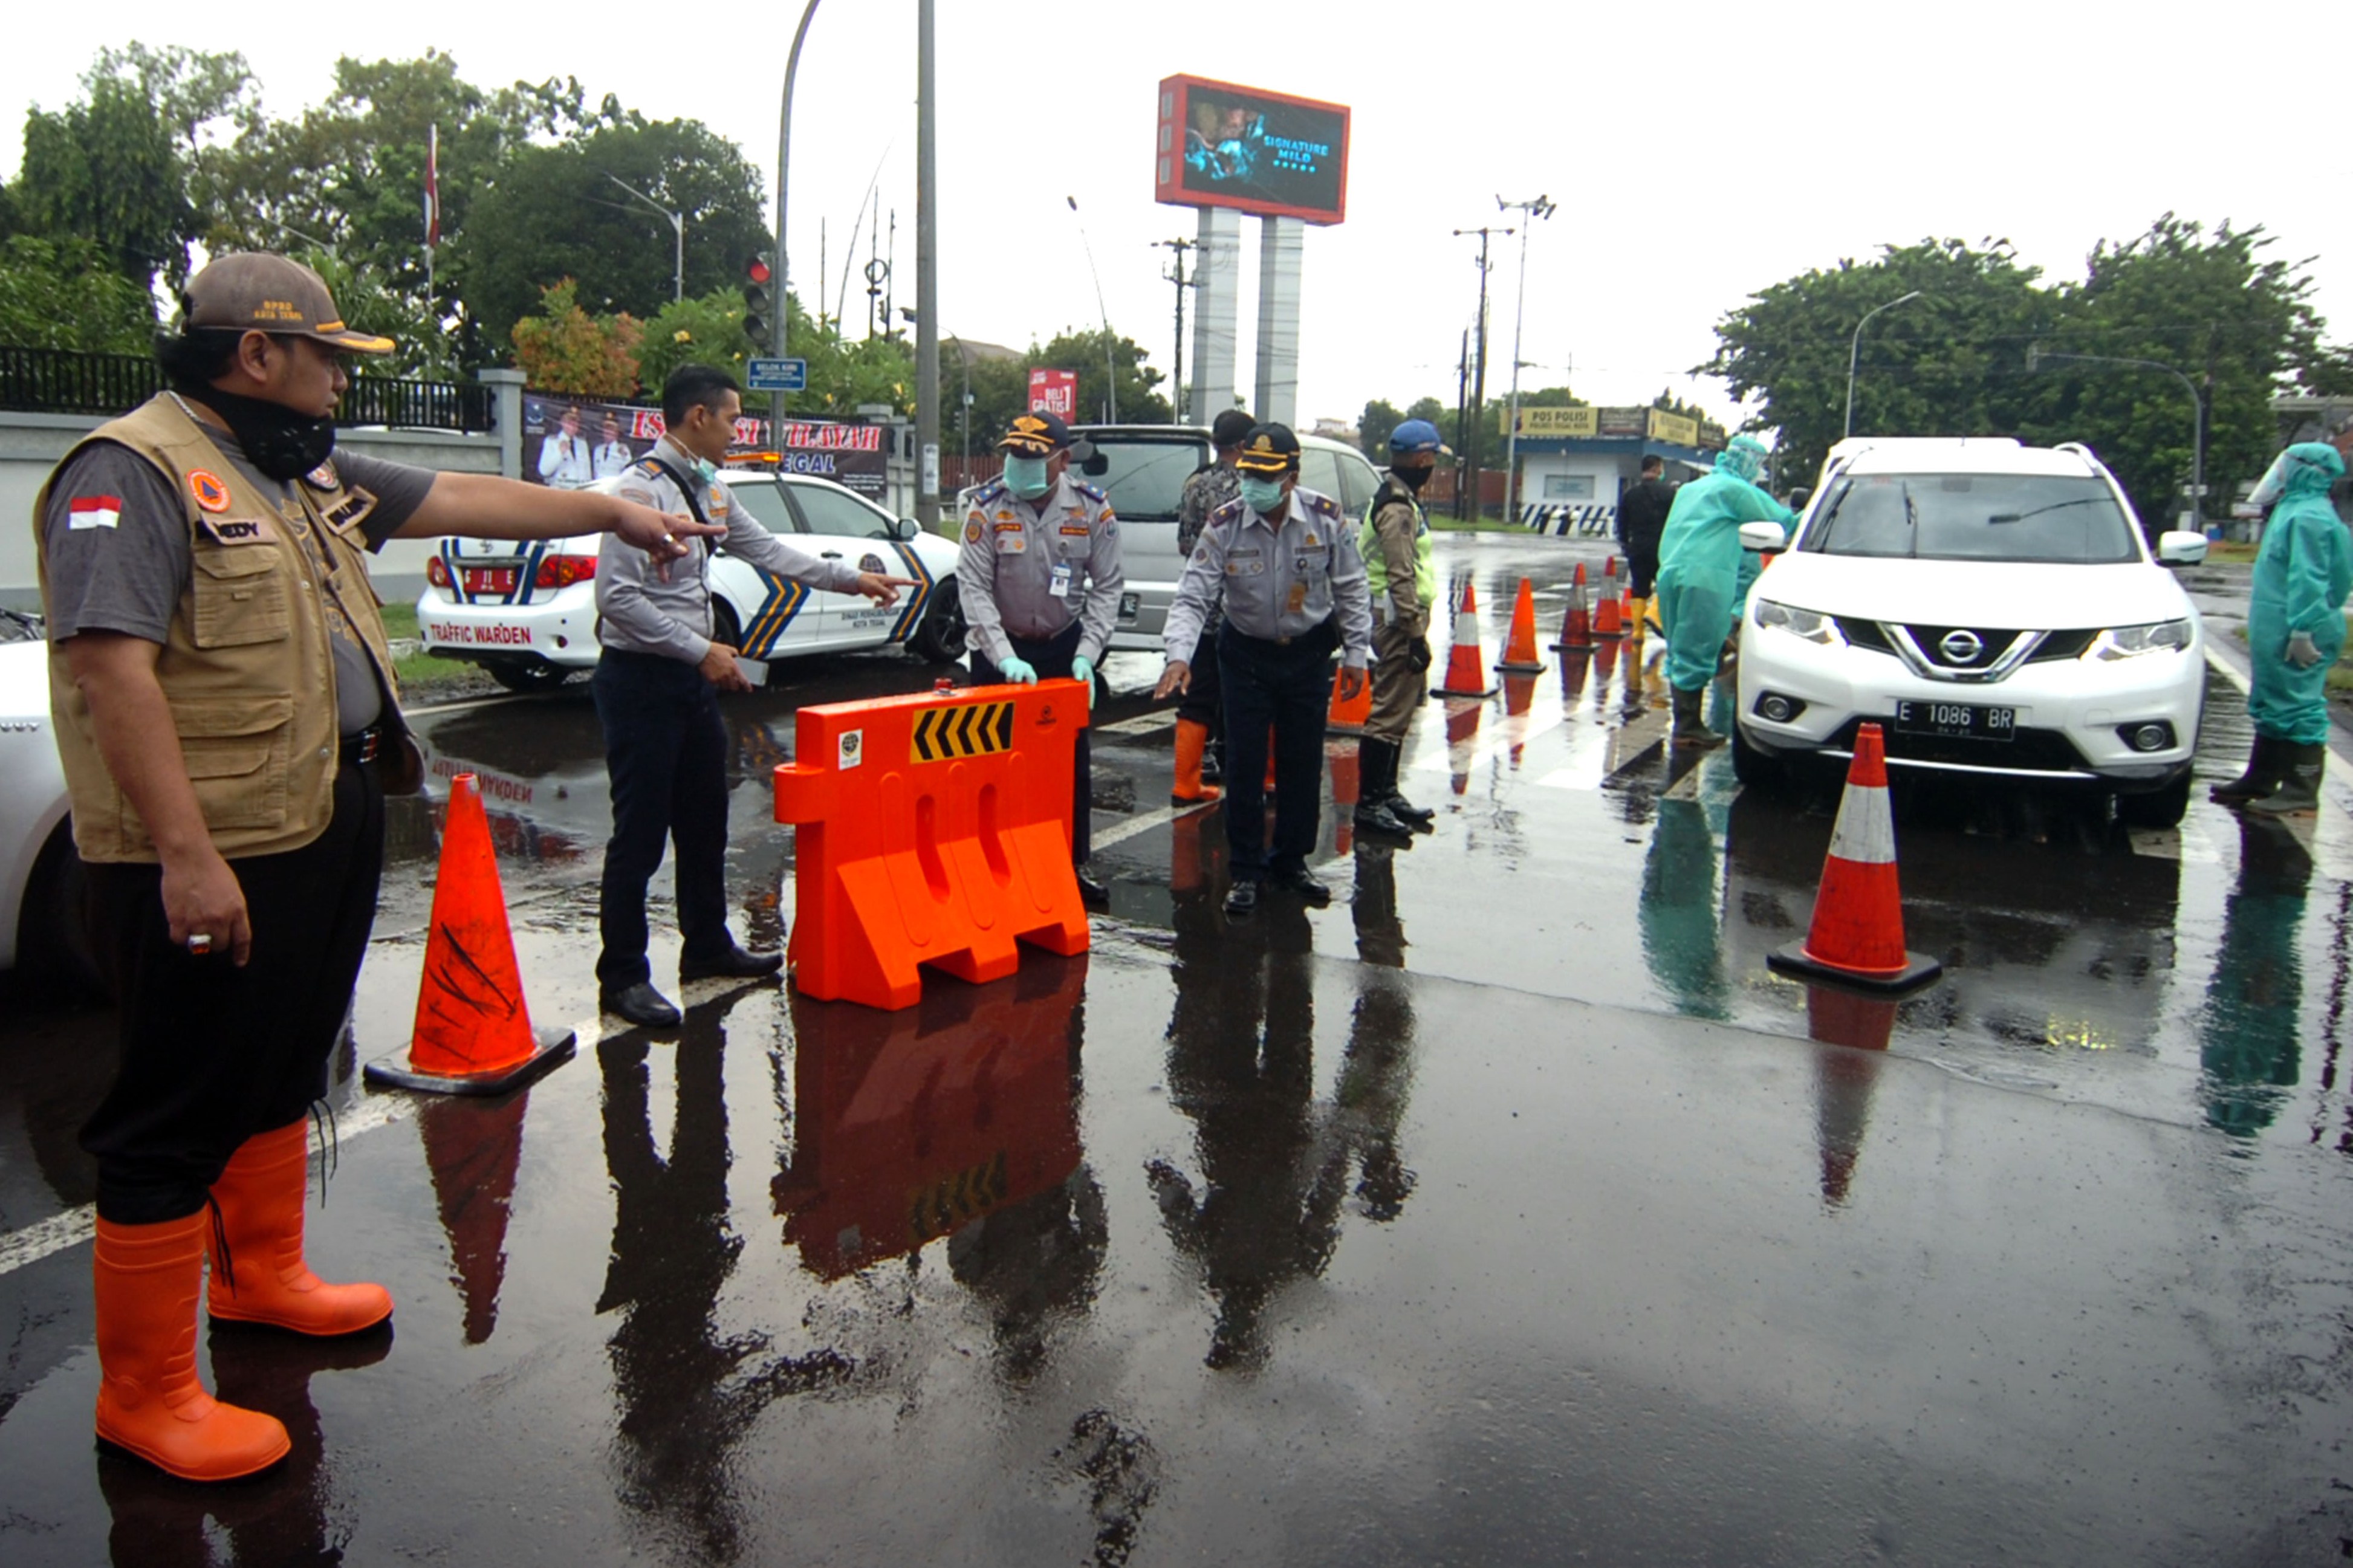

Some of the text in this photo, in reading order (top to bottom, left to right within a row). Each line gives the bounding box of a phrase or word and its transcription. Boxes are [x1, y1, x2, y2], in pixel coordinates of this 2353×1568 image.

[1265, 135, 1328, 157] SIGNATURE
[1279, 149, 1311, 163] MILD
[1045, 388, 1063, 400] BELI
[1533, 411, 1552, 422] POS
[1555, 411, 1588, 422] POLISI
[630, 410, 759, 445] ISSI
[430, 624, 531, 645] TRAFFIC WARDEN
[1900, 702, 2013, 728] E 1086 BR
